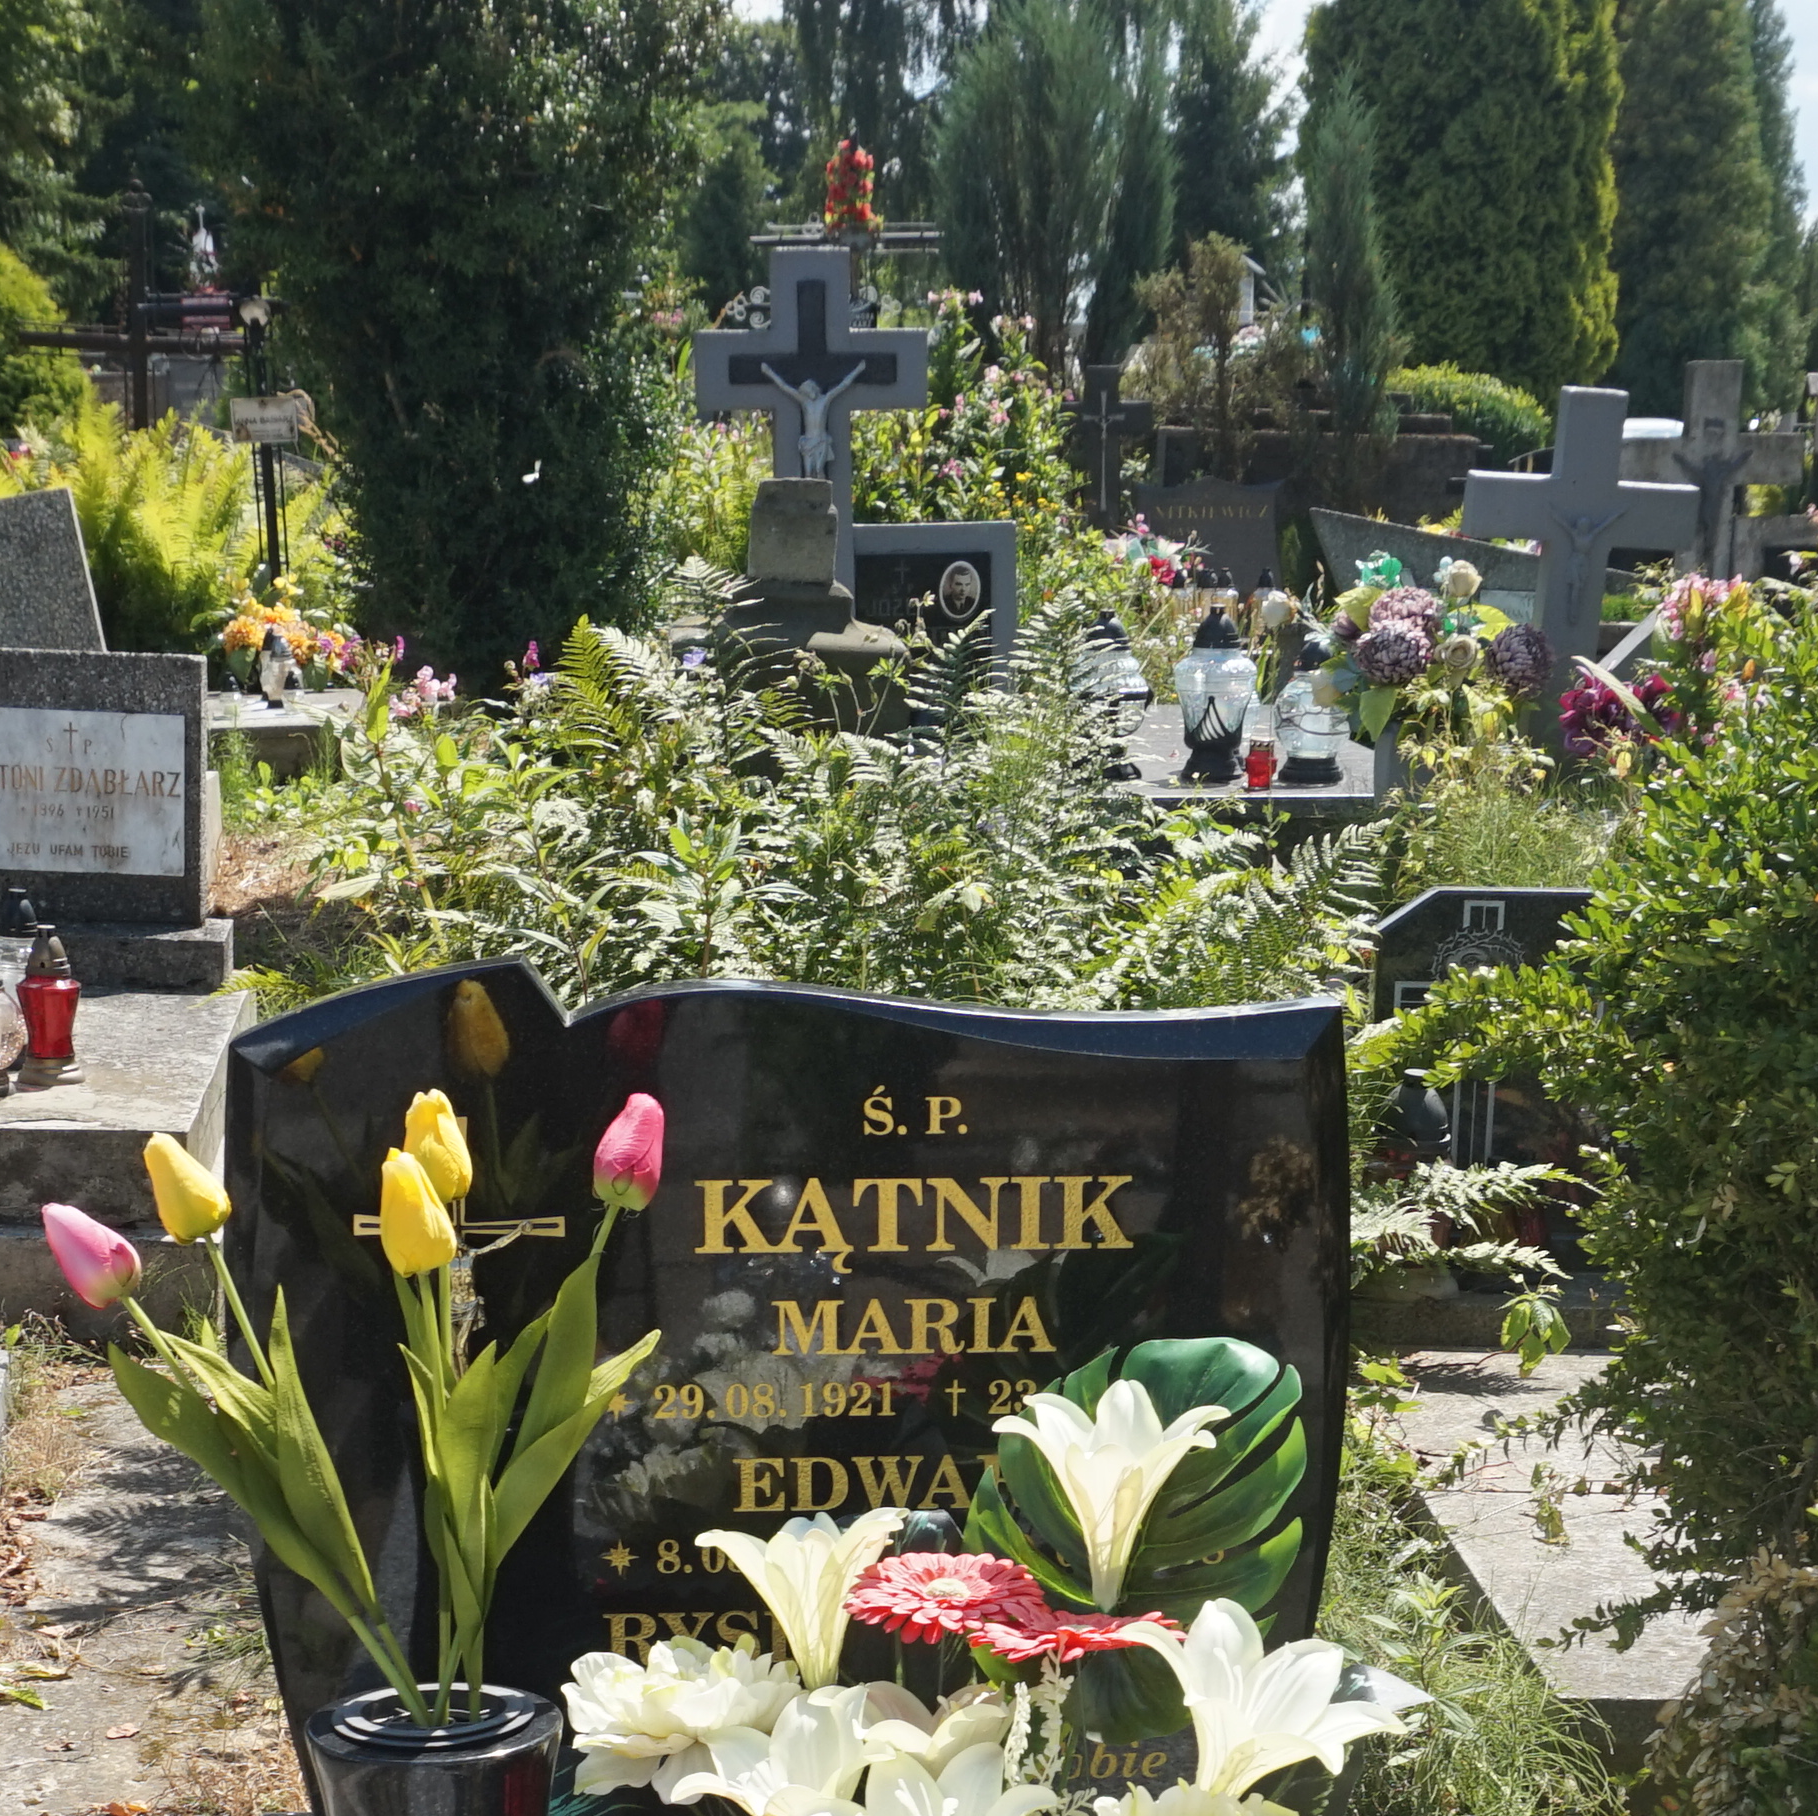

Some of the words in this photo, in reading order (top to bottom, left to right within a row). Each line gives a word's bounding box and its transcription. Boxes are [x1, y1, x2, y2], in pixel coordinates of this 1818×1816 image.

[86, 804, 115, 820] 1951
[7, 842, 41, 857] JEZU
[49, 843, 84, 858] UFAM
[91, 844, 130, 859] TOBIE
[862, 1084, 908, 1136] Ś.
[924, 1096, 969, 1136] P.
[693, 1174, 1135, 1275] KĄTNIK
[771, 1295, 1058, 1356] MARIA
[655, 1538, 746, 1575] 8.0
[1065, 1739, 1169, 1780] obie
